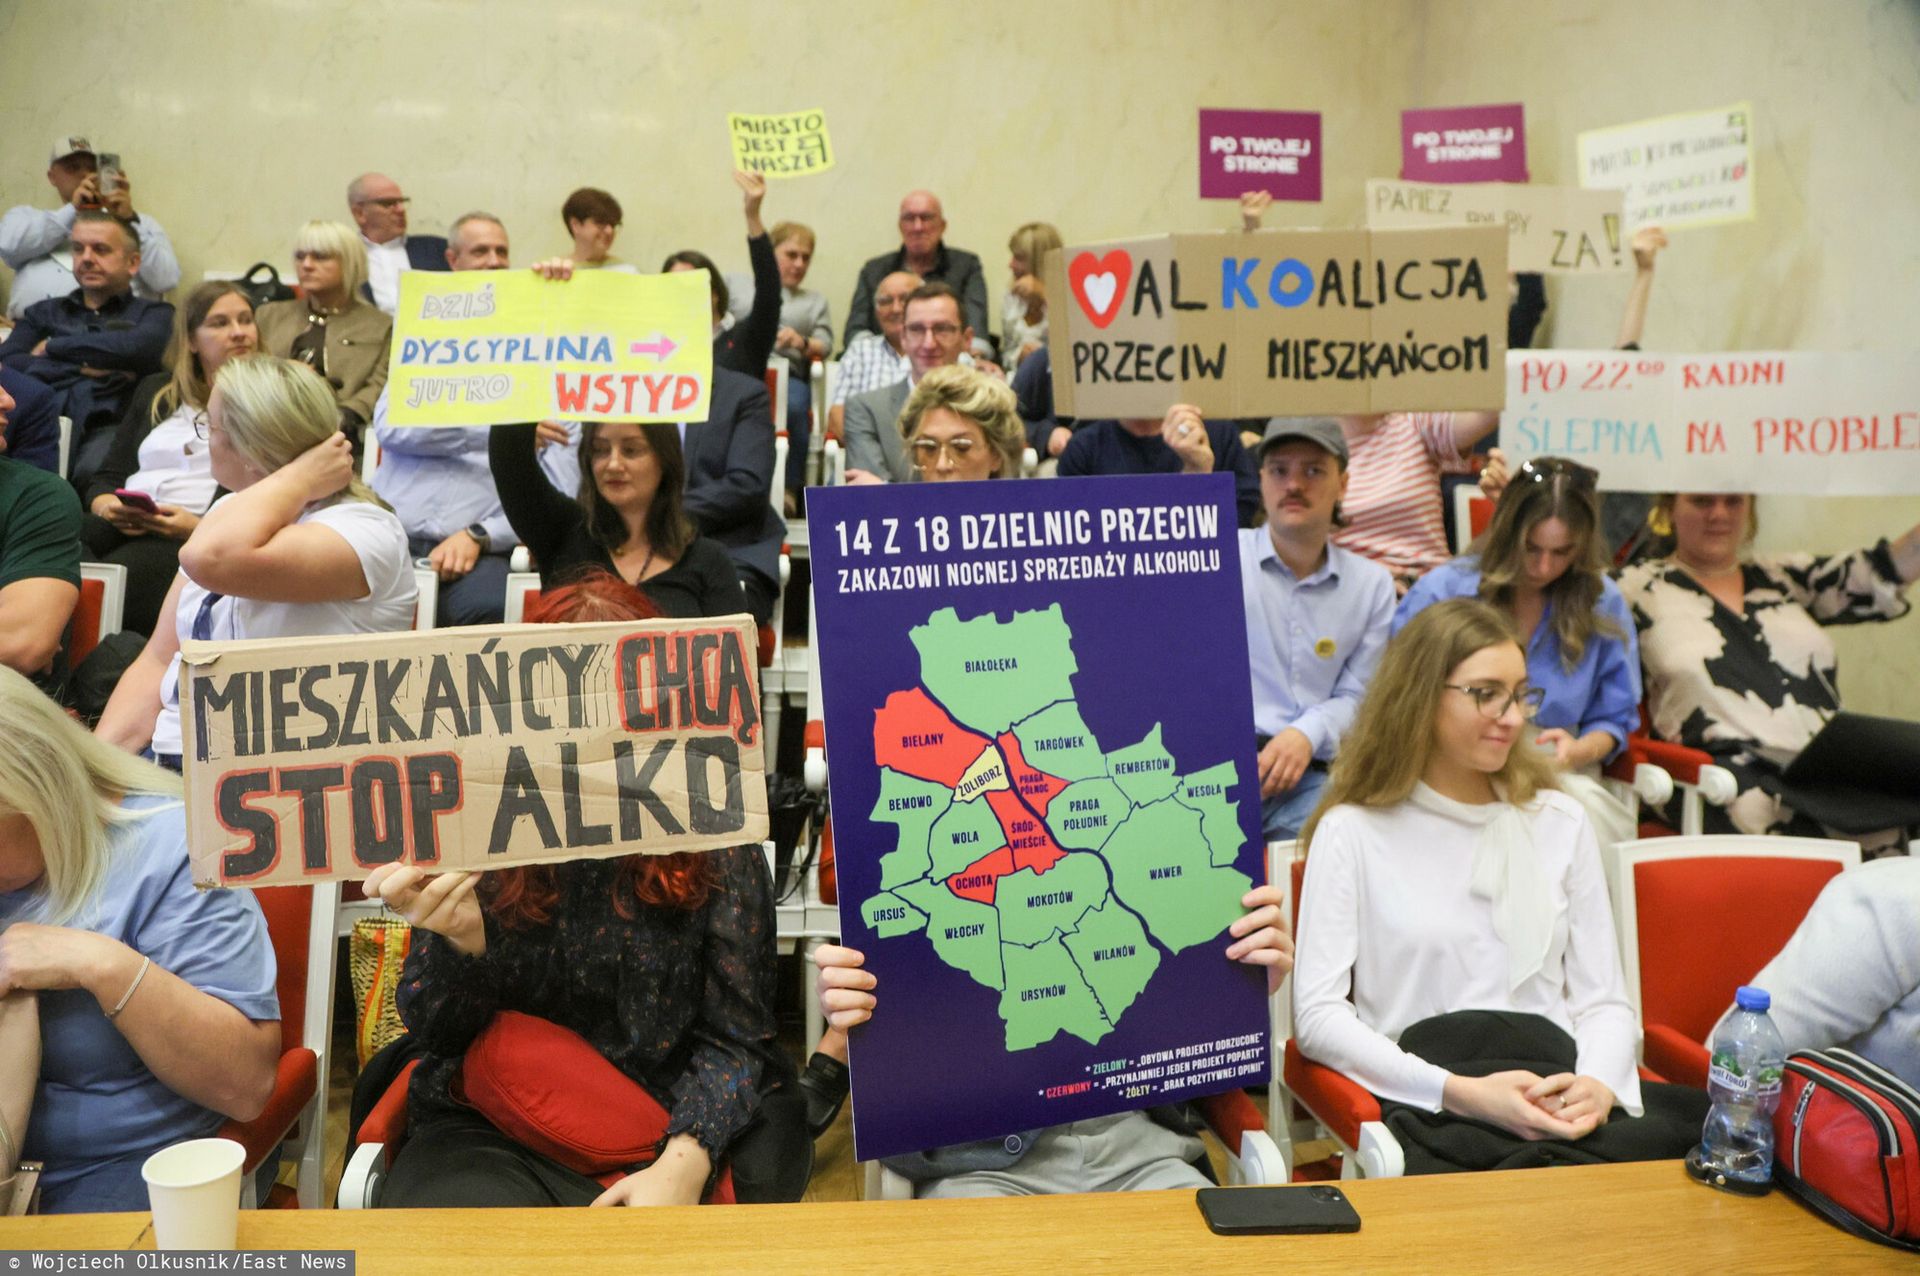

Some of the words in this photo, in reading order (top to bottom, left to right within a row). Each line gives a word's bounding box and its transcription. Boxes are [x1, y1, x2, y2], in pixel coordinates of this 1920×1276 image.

[733, 114, 822, 134] MIASTO
[738, 136, 785, 152] JEST
[1210, 136, 1238, 153] PO
[1241, 137, 1311, 157] TWOJEJ
[1413, 132, 1440, 148] PO
[1443, 127, 1514, 145] TWOJEJ
[1426, 144, 1501, 162] STRONIE
[743, 155, 814, 171] NASZE
[1223, 155, 1299, 174] STRONIE
[1551, 213, 1621, 268] ZA!
[422, 284, 496, 319] DZIŚ
[401, 336, 613, 364] DYSCYPLINA
[1073, 341, 1227, 384] PRZECIW
[1267, 330, 1489, 381] MIESZKAŃCOM
[1520, 358, 1567, 394] PO
[1683, 359, 1785, 390] RADNI
[406, 374, 510, 408] JUTRO
[556, 373, 699, 414] WSTYD
[1686, 420, 1727, 455] NA
[1753, 412, 1920, 455] PROBLE
[834, 518, 872, 557] 14
[883, 517, 901, 554] Z
[915, 515, 950, 553] 18
[961, 508, 1092, 551] DZIELNIC
[1101, 504, 1219, 543] PRZECIW
[838, 563, 940, 593] ZAKAZOWI
[947, 559, 1017, 587] NOCNEJ
[1024, 551, 1126, 582] SPRZEDAŻY
[1133, 549, 1221, 576] ALKOHOLU
[964, 656, 1018, 674] BIAŁOŁĘKA
[193, 638, 609, 762] MIESZKAŃCY
[614, 628, 760, 747] CHCĄ
[902, 733, 944, 748] BIELANY
[1034, 736, 1084, 752] TARGÓWEK
[1115, 758, 1170, 774] REMBERTÓW
[1187, 784, 1222, 798] WESOŁA
[214, 749, 464, 881] STOP
[488, 735, 746, 854] ALKO
[889, 795, 932, 811] BEMOWO
[1070, 798, 1100, 812] PRAGA
[1011, 820, 1037, 834] ŚRÓD-
[1063, 815, 1108, 831] POŁUDNIE
[951, 831, 979, 845] WOLA
[1012, 835, 1047, 848] MIEŚCIE
[1149, 865, 1182, 880] WAWER
[955, 874, 993, 890] OCHOTA
[1027, 890, 1073, 908] MOKOTÓW
[873, 907, 906, 922] URSUS
[944, 923, 985, 940] WŁOCHY
[1093, 945, 1136, 962] WILANÓW
[1021, 984, 1066, 1001] URSYNÓW
[1092, 1059, 1127, 1075] ZIELONY
[1175, 1042, 1214, 1059] PROJEKTY
[1046, 1080, 1092, 1098] CZERWONY
[1166, 1061, 1191, 1076] JEDEN
[1192, 1054, 1225, 1071] PROJEKT
[1125, 1083, 1151, 1098] ŻÓŁTY
[1187, 1067, 1236, 1086] POZYTYWNEJ
